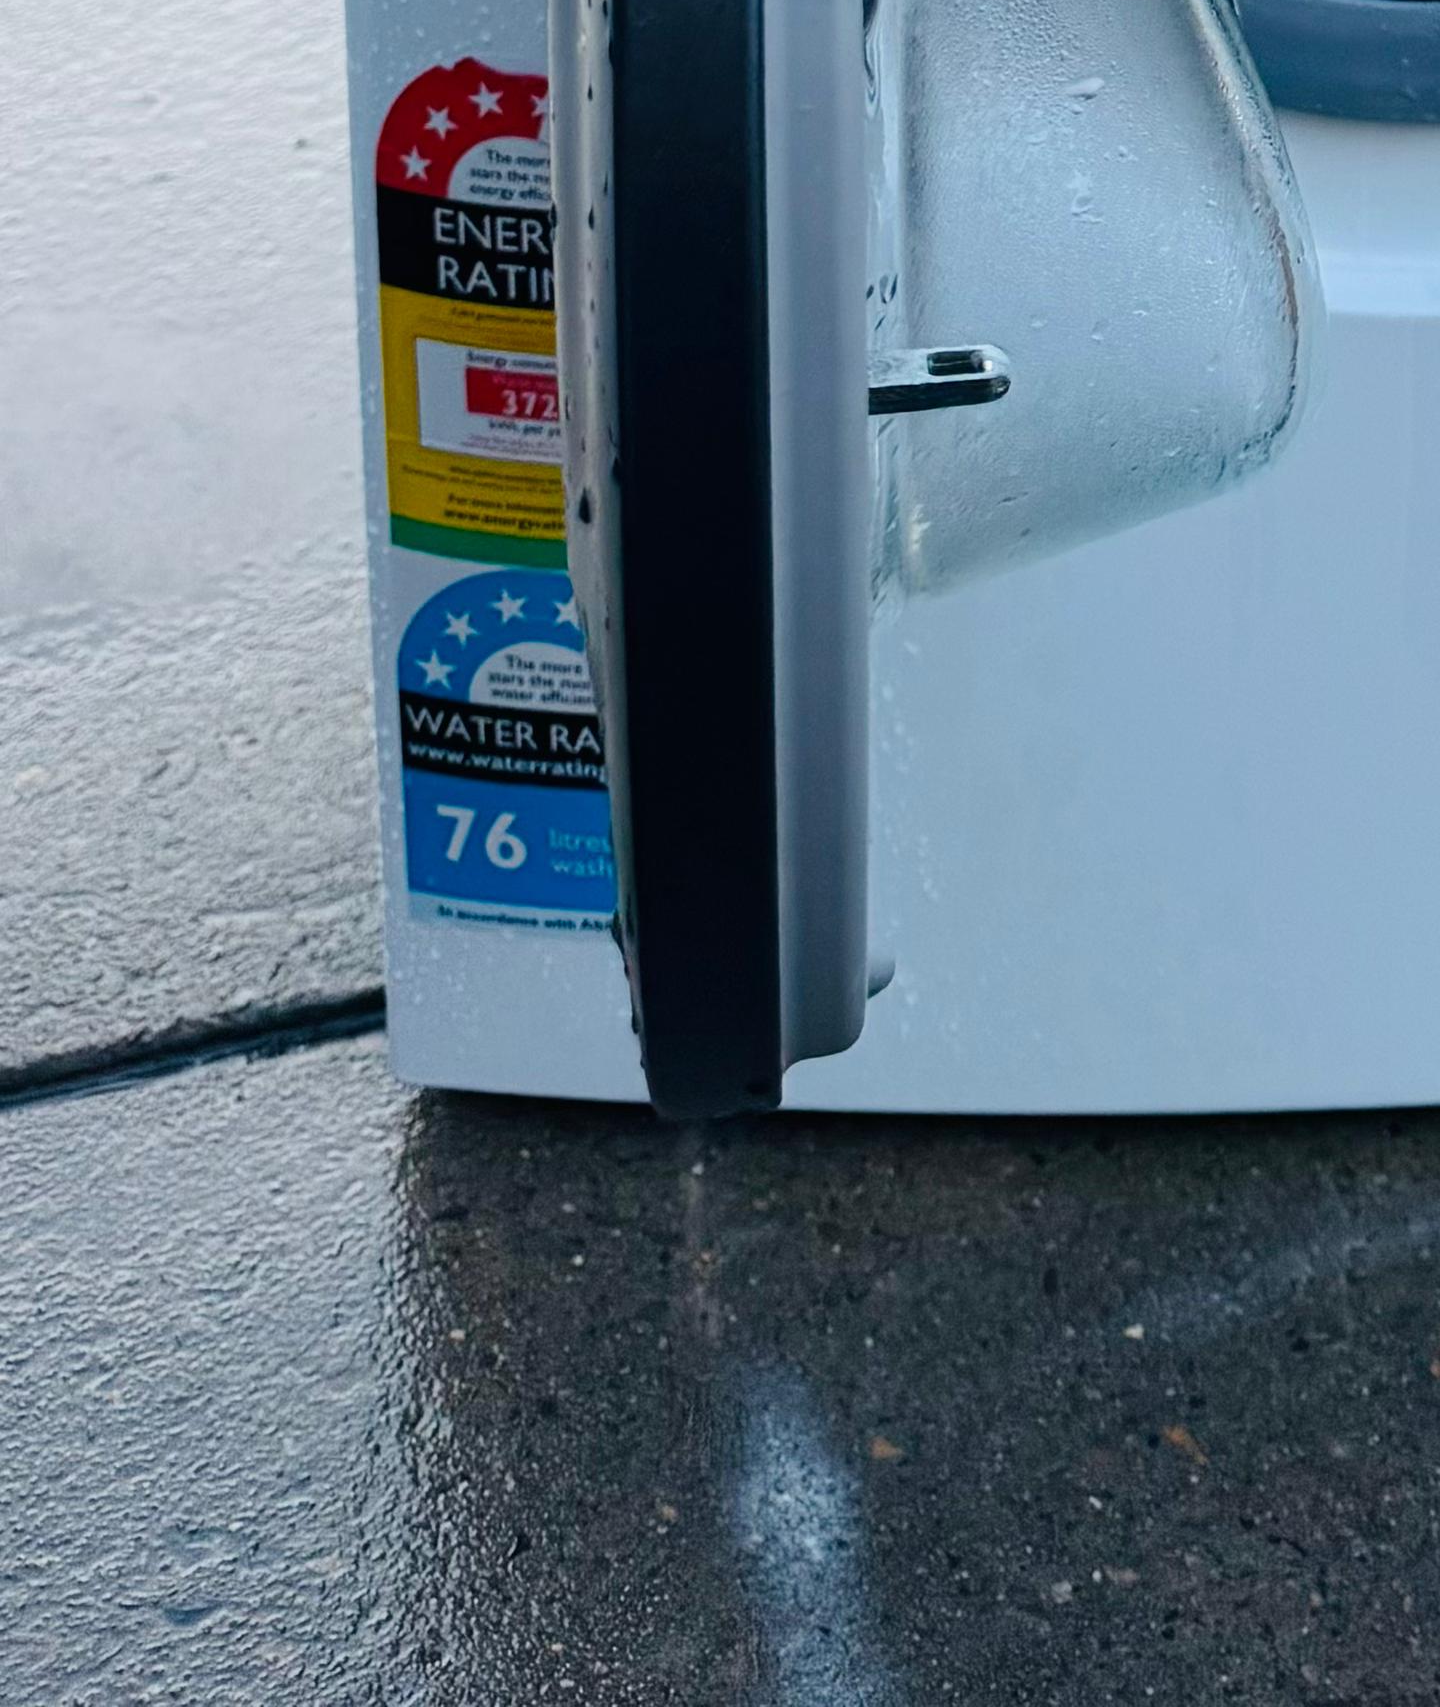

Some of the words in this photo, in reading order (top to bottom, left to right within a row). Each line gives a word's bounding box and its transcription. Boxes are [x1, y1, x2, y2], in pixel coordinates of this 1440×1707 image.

[486, 149, 513, 166] The
[516, 156, 551, 169] mor
[433, 206, 555, 255] ENER
[501, 390, 558, 419] 372
[405, 703, 538, 750] WATER
[552, 723, 601, 755] RA
[436, 803, 528, 870] 76
